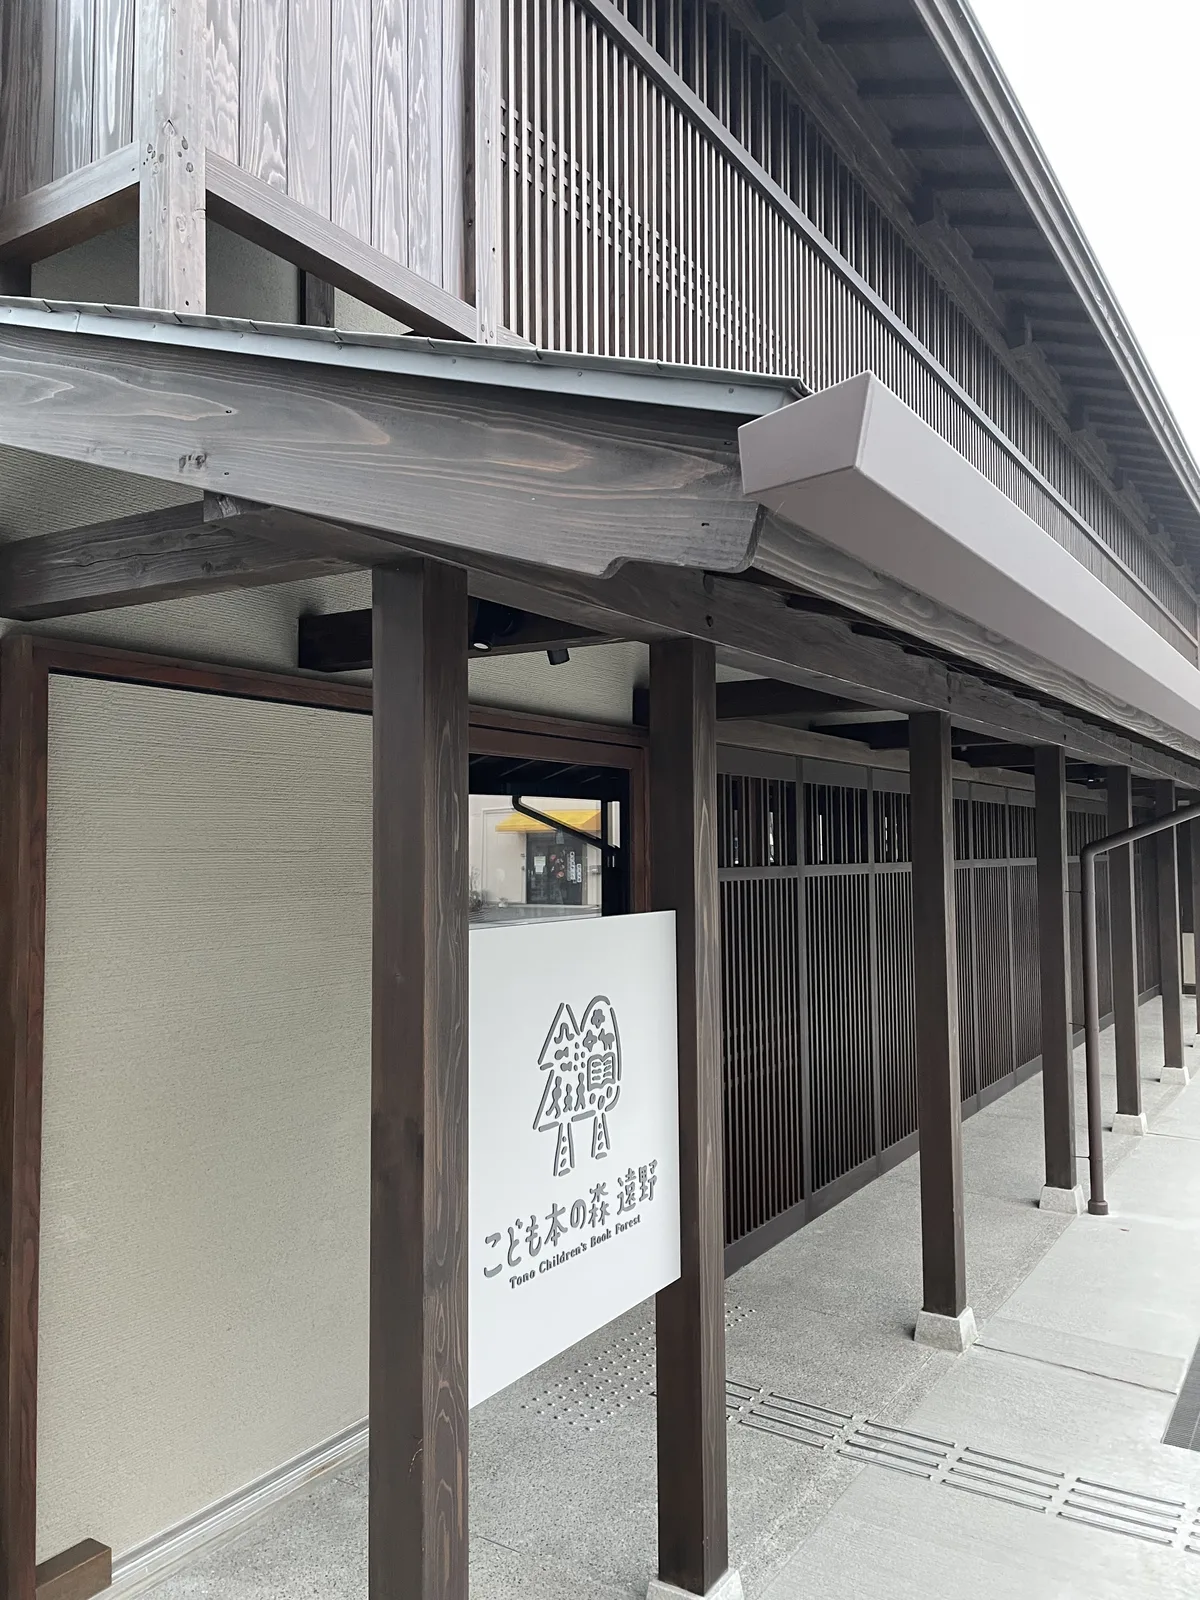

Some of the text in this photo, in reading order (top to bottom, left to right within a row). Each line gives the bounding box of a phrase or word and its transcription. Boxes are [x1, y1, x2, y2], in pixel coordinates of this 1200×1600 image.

[484, 1159, 658, 1278] こども本の森 遠野
[509, 1214, 641, 1289] Tono Children's Book Forest
